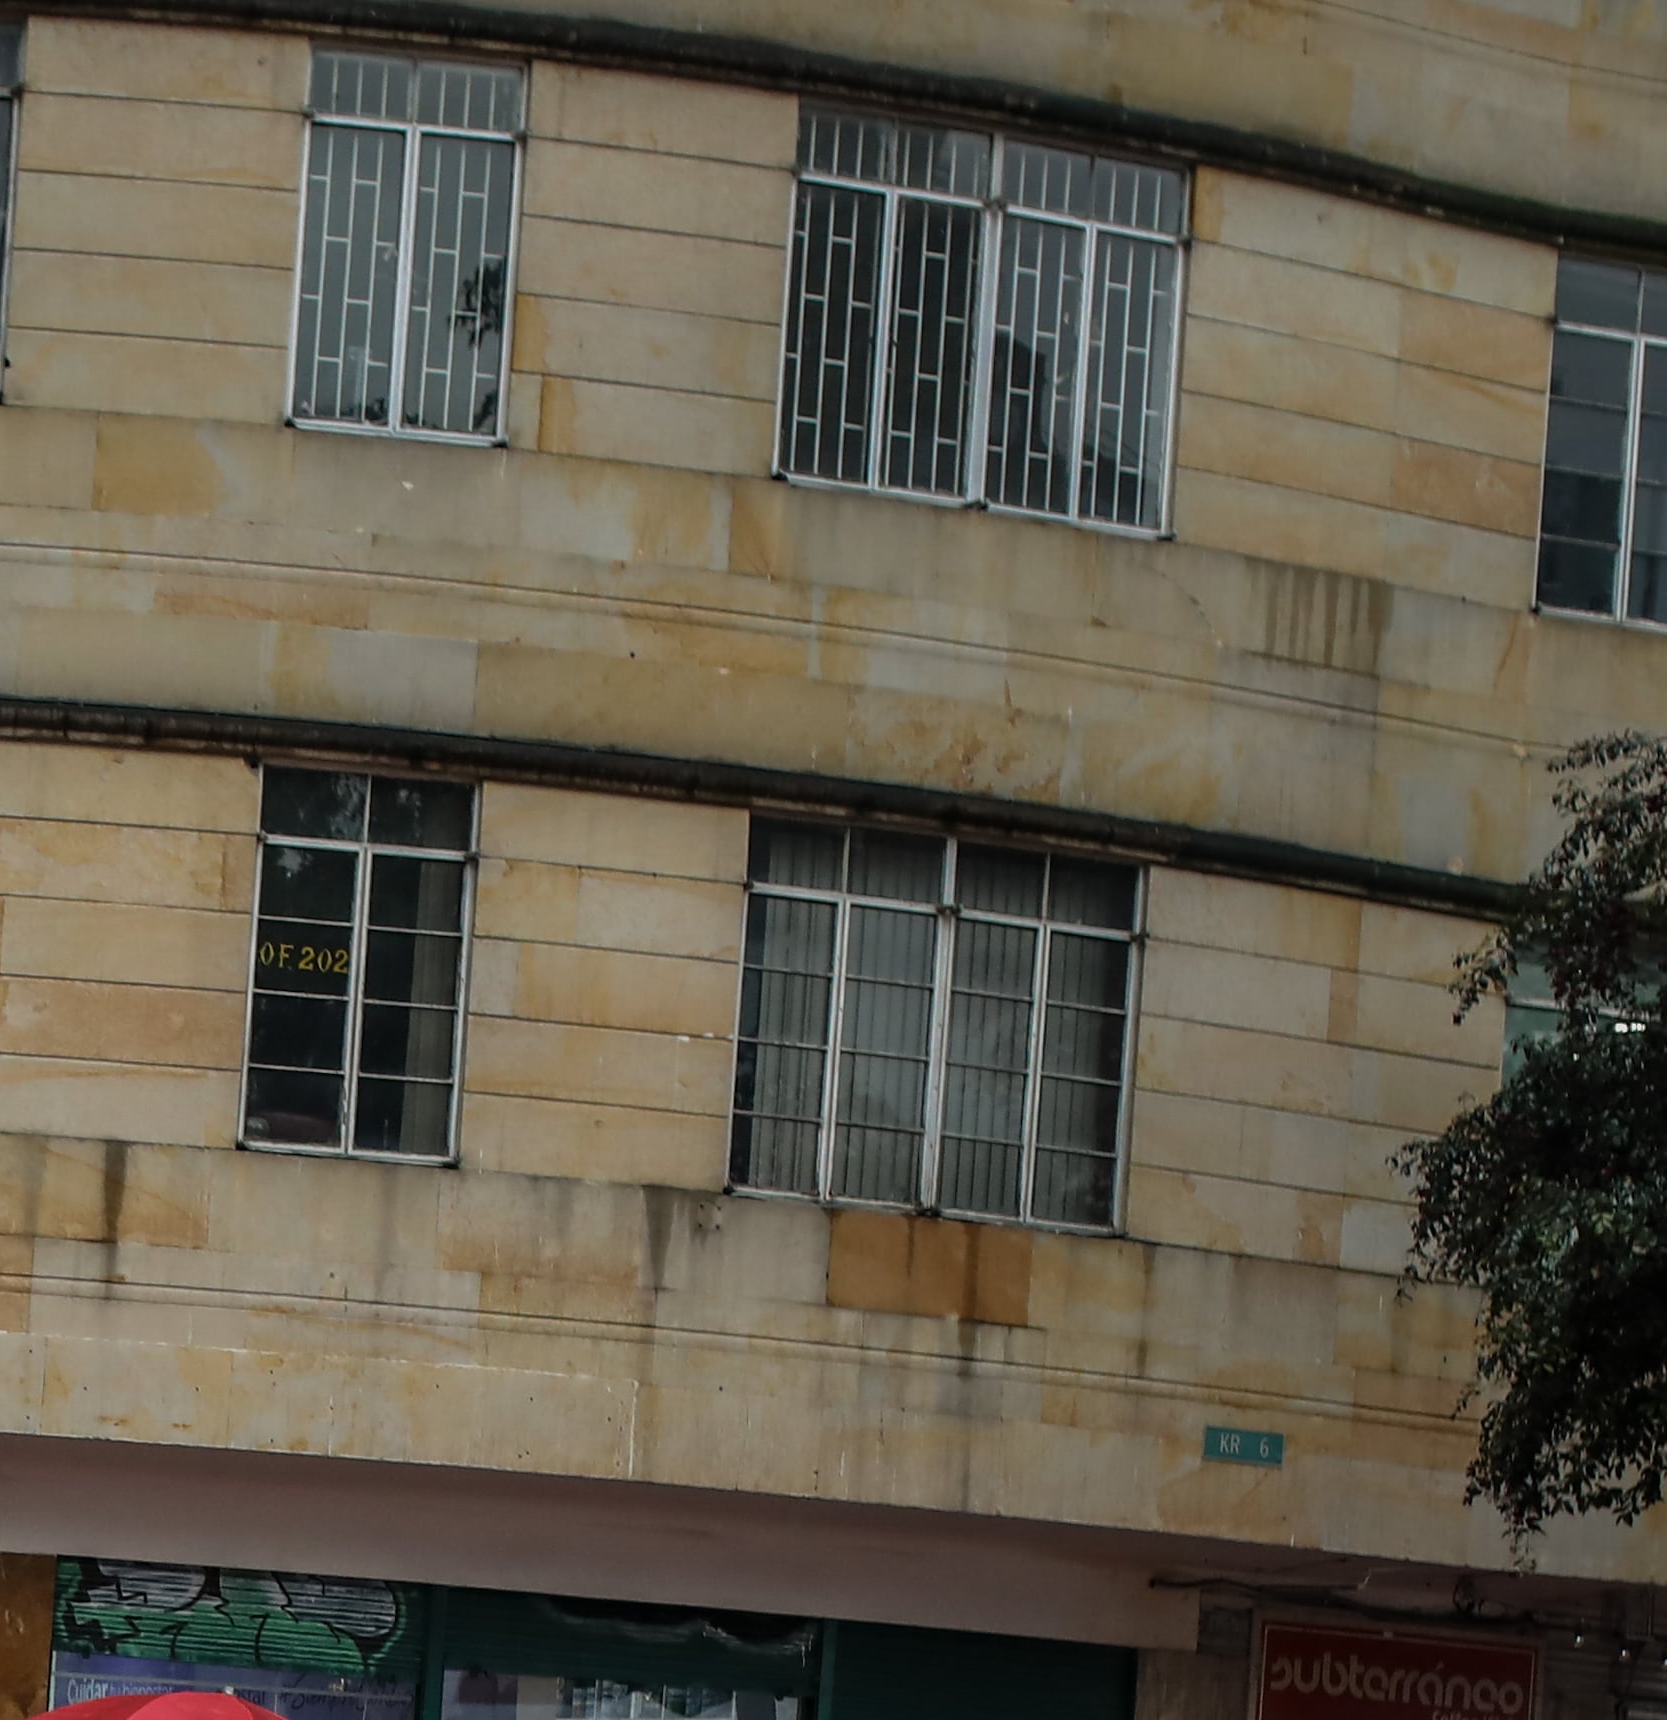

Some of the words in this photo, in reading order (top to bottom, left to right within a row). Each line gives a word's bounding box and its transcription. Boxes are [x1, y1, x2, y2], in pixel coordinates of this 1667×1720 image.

[298, 946, 350, 974] 202
[1219, 1432, 1241, 1455] KR
[1259, 1436, 1270, 1459] 6
[67, 1677, 108, 1701] Cuidar
[1270, 1651, 1524, 1715] subterráneo
